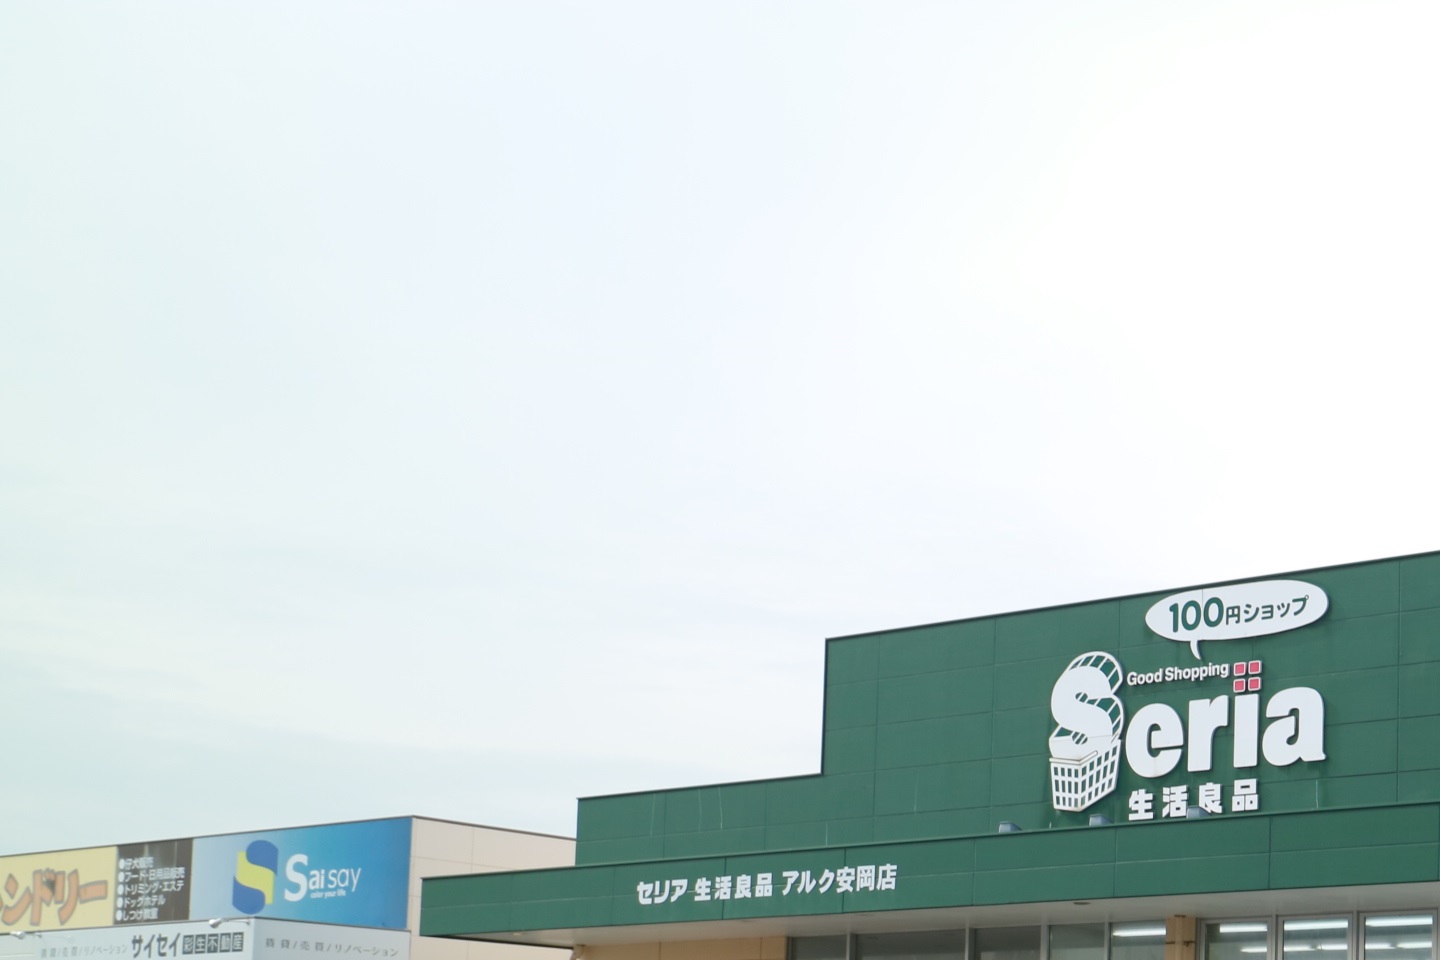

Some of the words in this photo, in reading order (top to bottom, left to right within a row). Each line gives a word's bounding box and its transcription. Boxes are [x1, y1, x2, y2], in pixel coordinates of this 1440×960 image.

[1169, 595, 1309, 633] 100円ショップ
[1126, 670, 1162, 686] Good
[1164, 663, 1229, 682] Shopping
[1049, 651, 1327, 812] Seria
[1128, 778, 1259, 821] 生活良品
[0, 867, 108, 926] ンドリー
[637, 879, 687, 905] セリア
[695, 873, 773, 901] 生活良品
[782, 864, 898, 896] アルク安岡店
